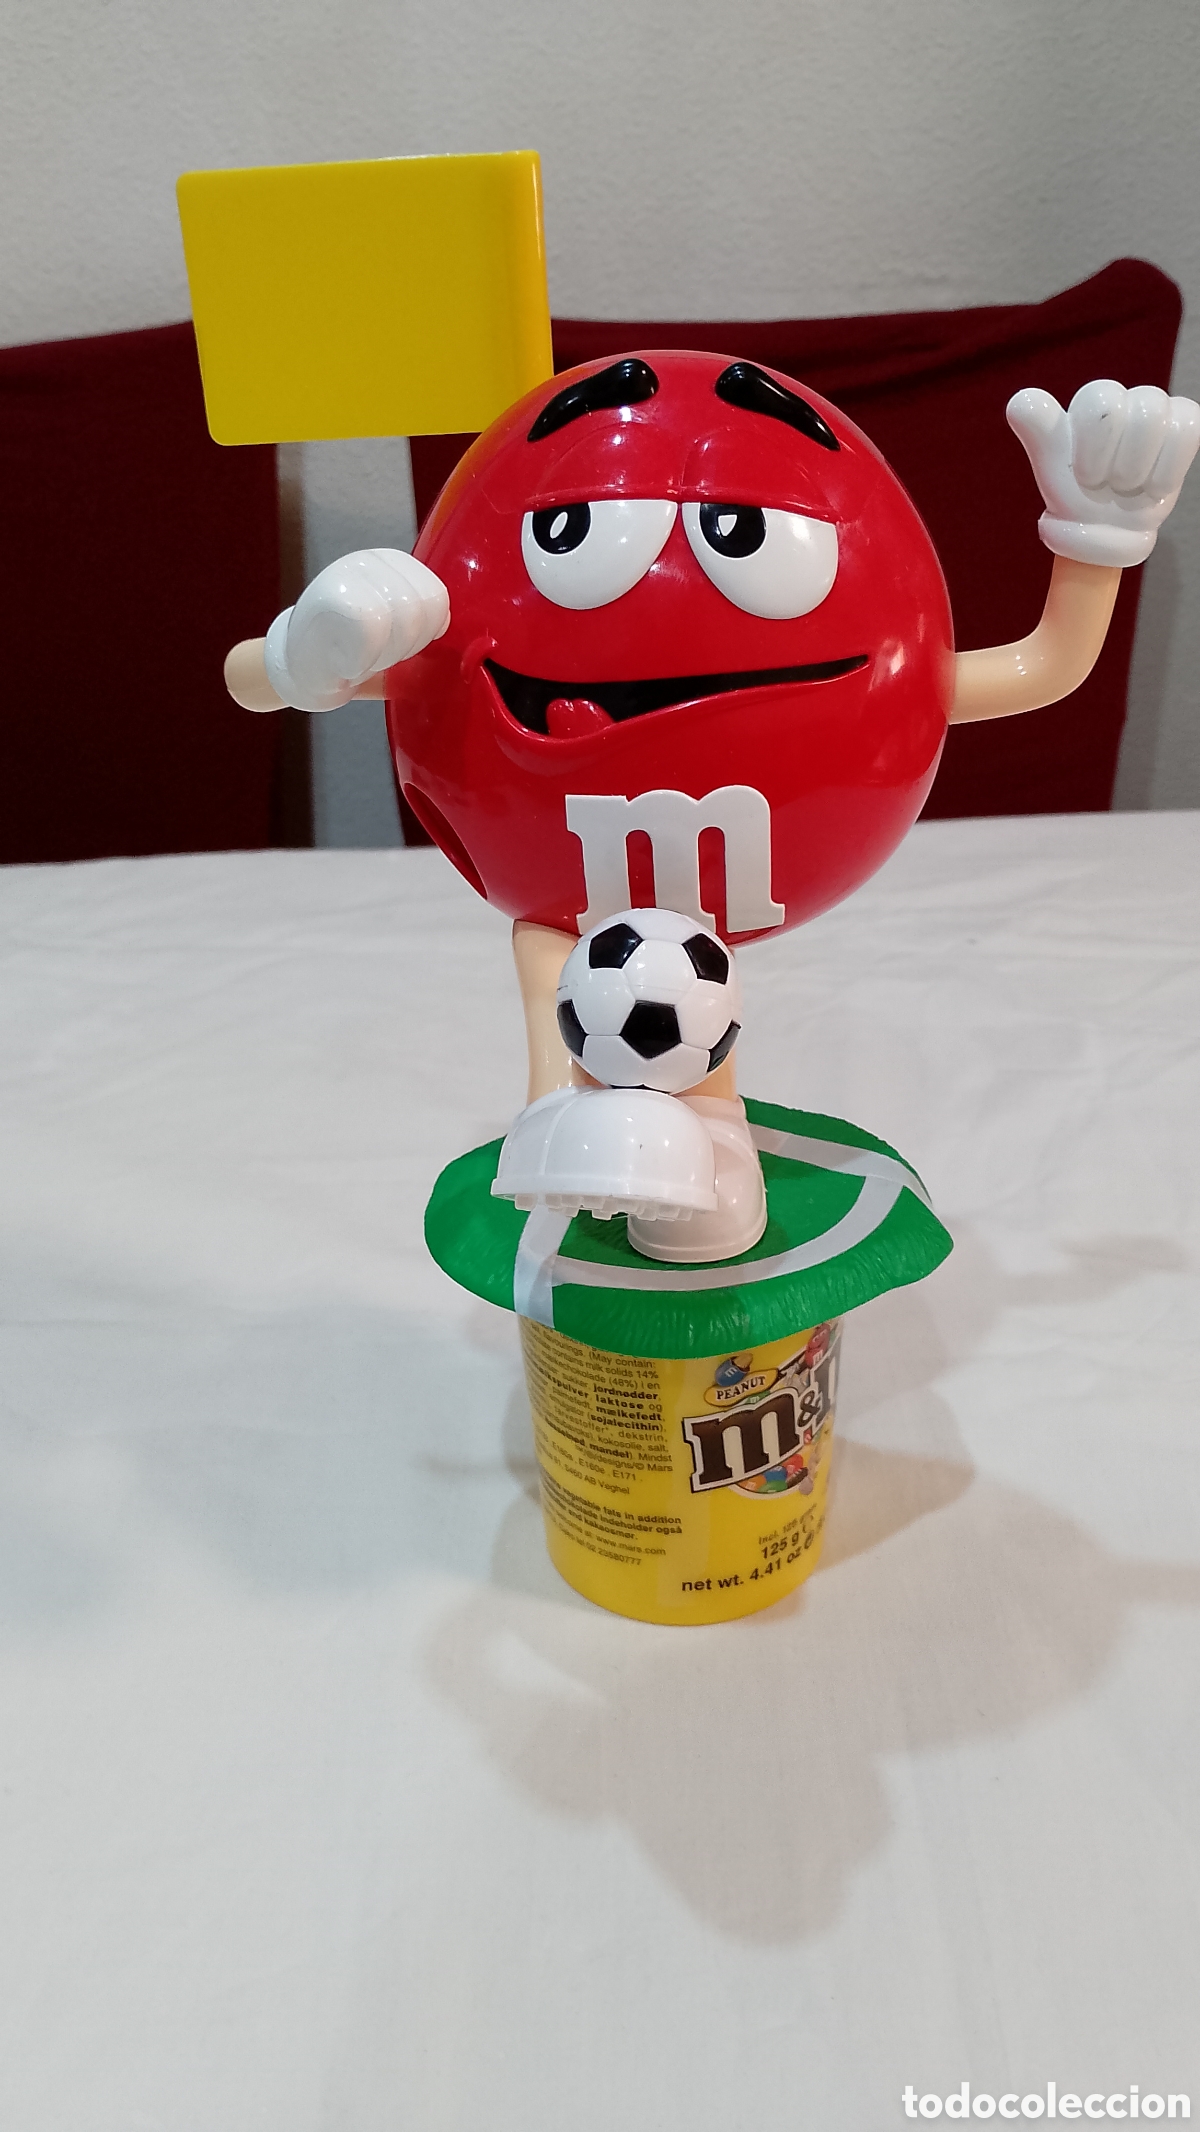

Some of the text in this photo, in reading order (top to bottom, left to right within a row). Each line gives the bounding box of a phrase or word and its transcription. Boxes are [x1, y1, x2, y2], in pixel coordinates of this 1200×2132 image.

[565, 785, 786, 933] m
[589, 1350, 612, 1366] (May
[615, 1357, 656, 1369] contain:
[605, 1366, 634, 1378] solids
[636, 1370, 660, 1380] 14%
[608, 1377, 639, 1391] (48%)
[646, 1381, 660, 1390] en
[715, 1376, 766, 1401] PEANUT
[595, 1393, 644, 1410] laktose
[648, 1402, 663, 1413] og
[618, 1426, 668, 1442] dekstrin,
[638, 1452, 673, 1463] Mindst
[647, 1463, 673, 1472] Mars
[584, 1474, 597, 1486] AB
[600, 1516, 653, 1533] indeholder
[655, 1523, 683, 1535] også
[624, 1511, 635, 1521] in
[637, 1513, 682, 1524] addition
[761, 1531, 800, 1560] 125 g
[681, 1545, 803, 1592] net wt. 4.41 oz
